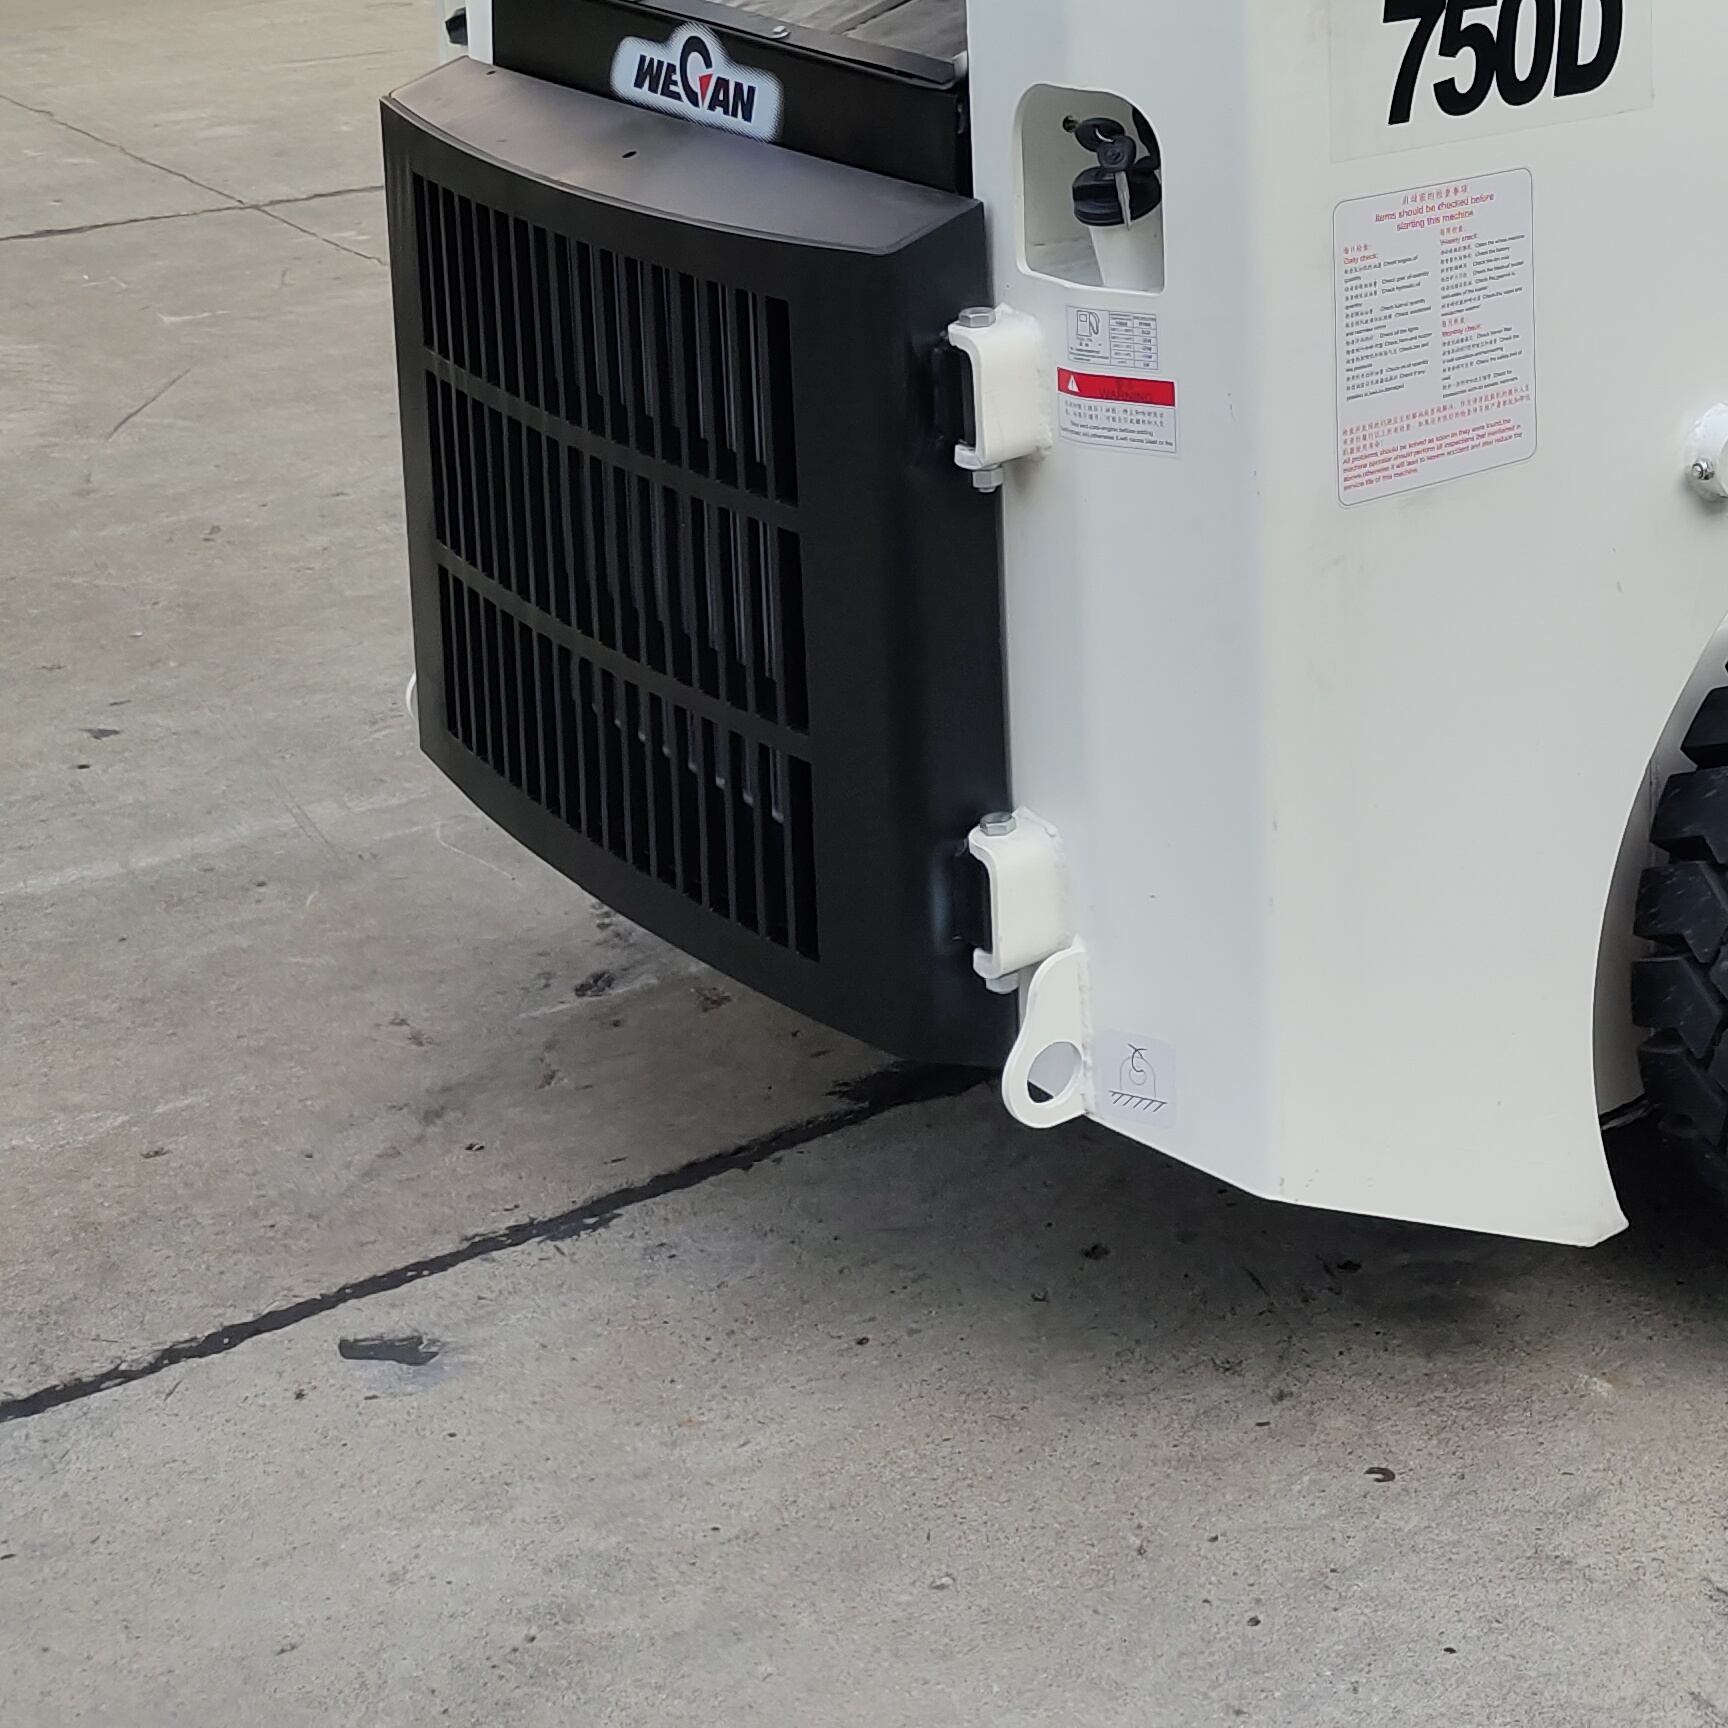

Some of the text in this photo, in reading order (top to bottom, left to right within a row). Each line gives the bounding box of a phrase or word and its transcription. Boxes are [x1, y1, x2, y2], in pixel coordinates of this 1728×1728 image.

[633, 35, 757, 123] WECAN
[1398, 205, 1424, 218] should
[1426, 205, 1435, 213] be
[1471, 194, 1494, 204] before
[1427, 215, 1440, 225] this
[1442, 210, 1474, 222] machine
